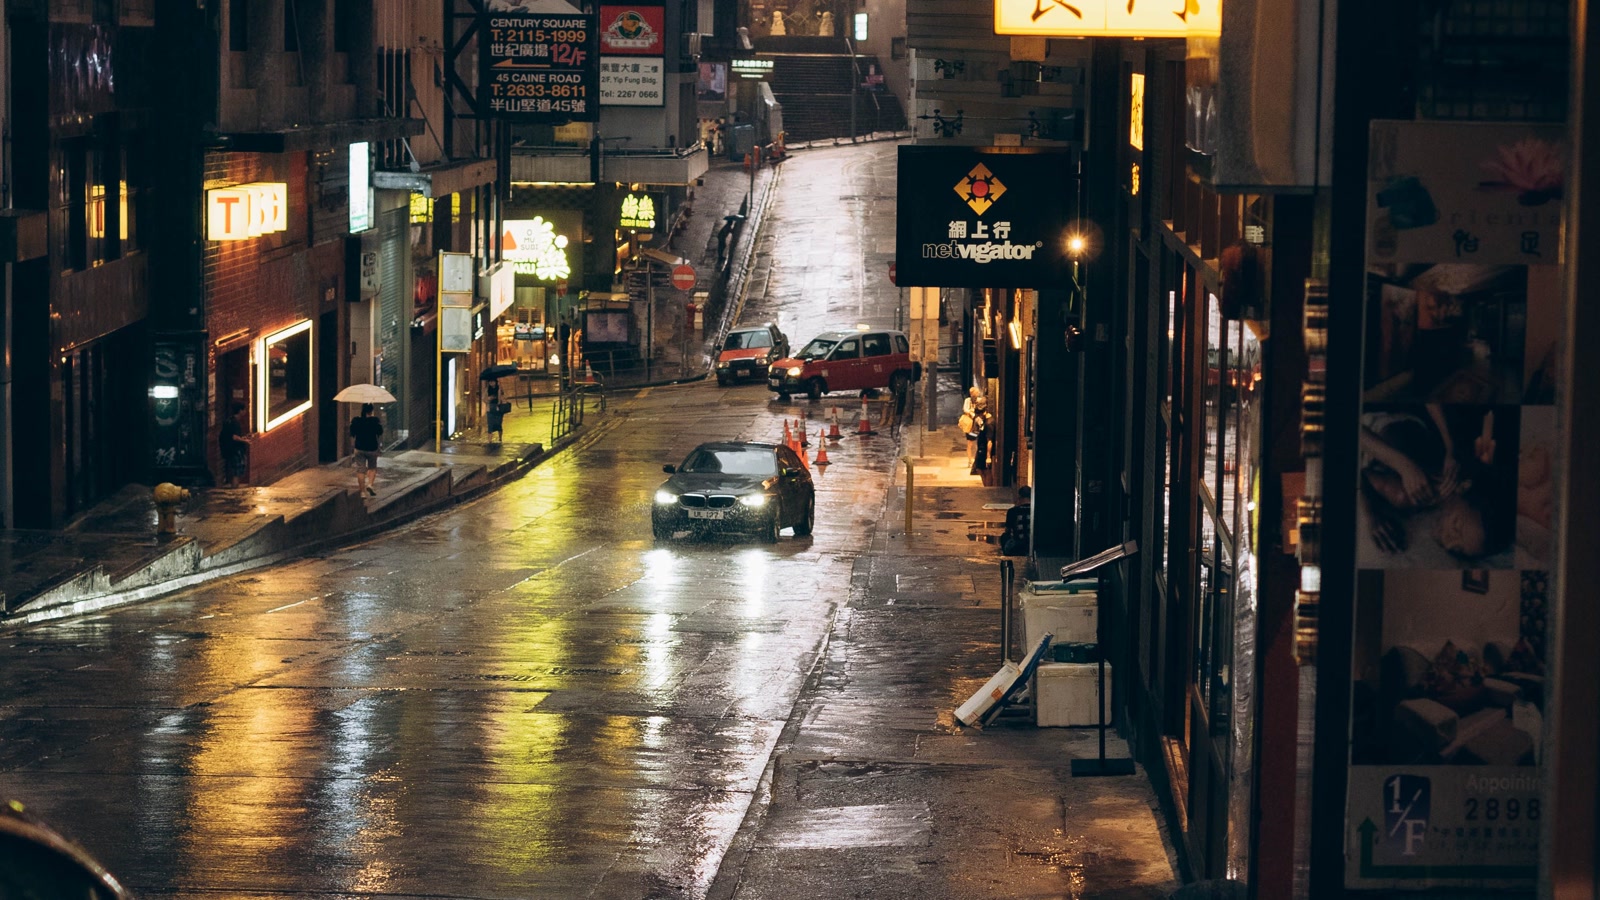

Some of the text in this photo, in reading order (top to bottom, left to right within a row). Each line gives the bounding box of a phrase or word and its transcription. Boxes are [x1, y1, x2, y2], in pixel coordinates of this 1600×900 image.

[490, 18, 586, 29] CENTURY SQUARE
[491, 29, 586, 42] T: 2115-1999
[490, 43, 549, 57] 世紀廣場
[550, 43, 586, 66] 12/F
[496, 73, 581, 84] 45 CAINE ROAD
[613, 76, 624, 85] Yip
[624, 76, 641, 85] Fung
[491, 84, 586, 98] T: 2633-8611
[600, 90, 615, 98] Tel:
[617, 90, 637, 98] 2267
[948, 220, 1011, 239] 網上行
[1464, 797, 1541, 821] 2898
